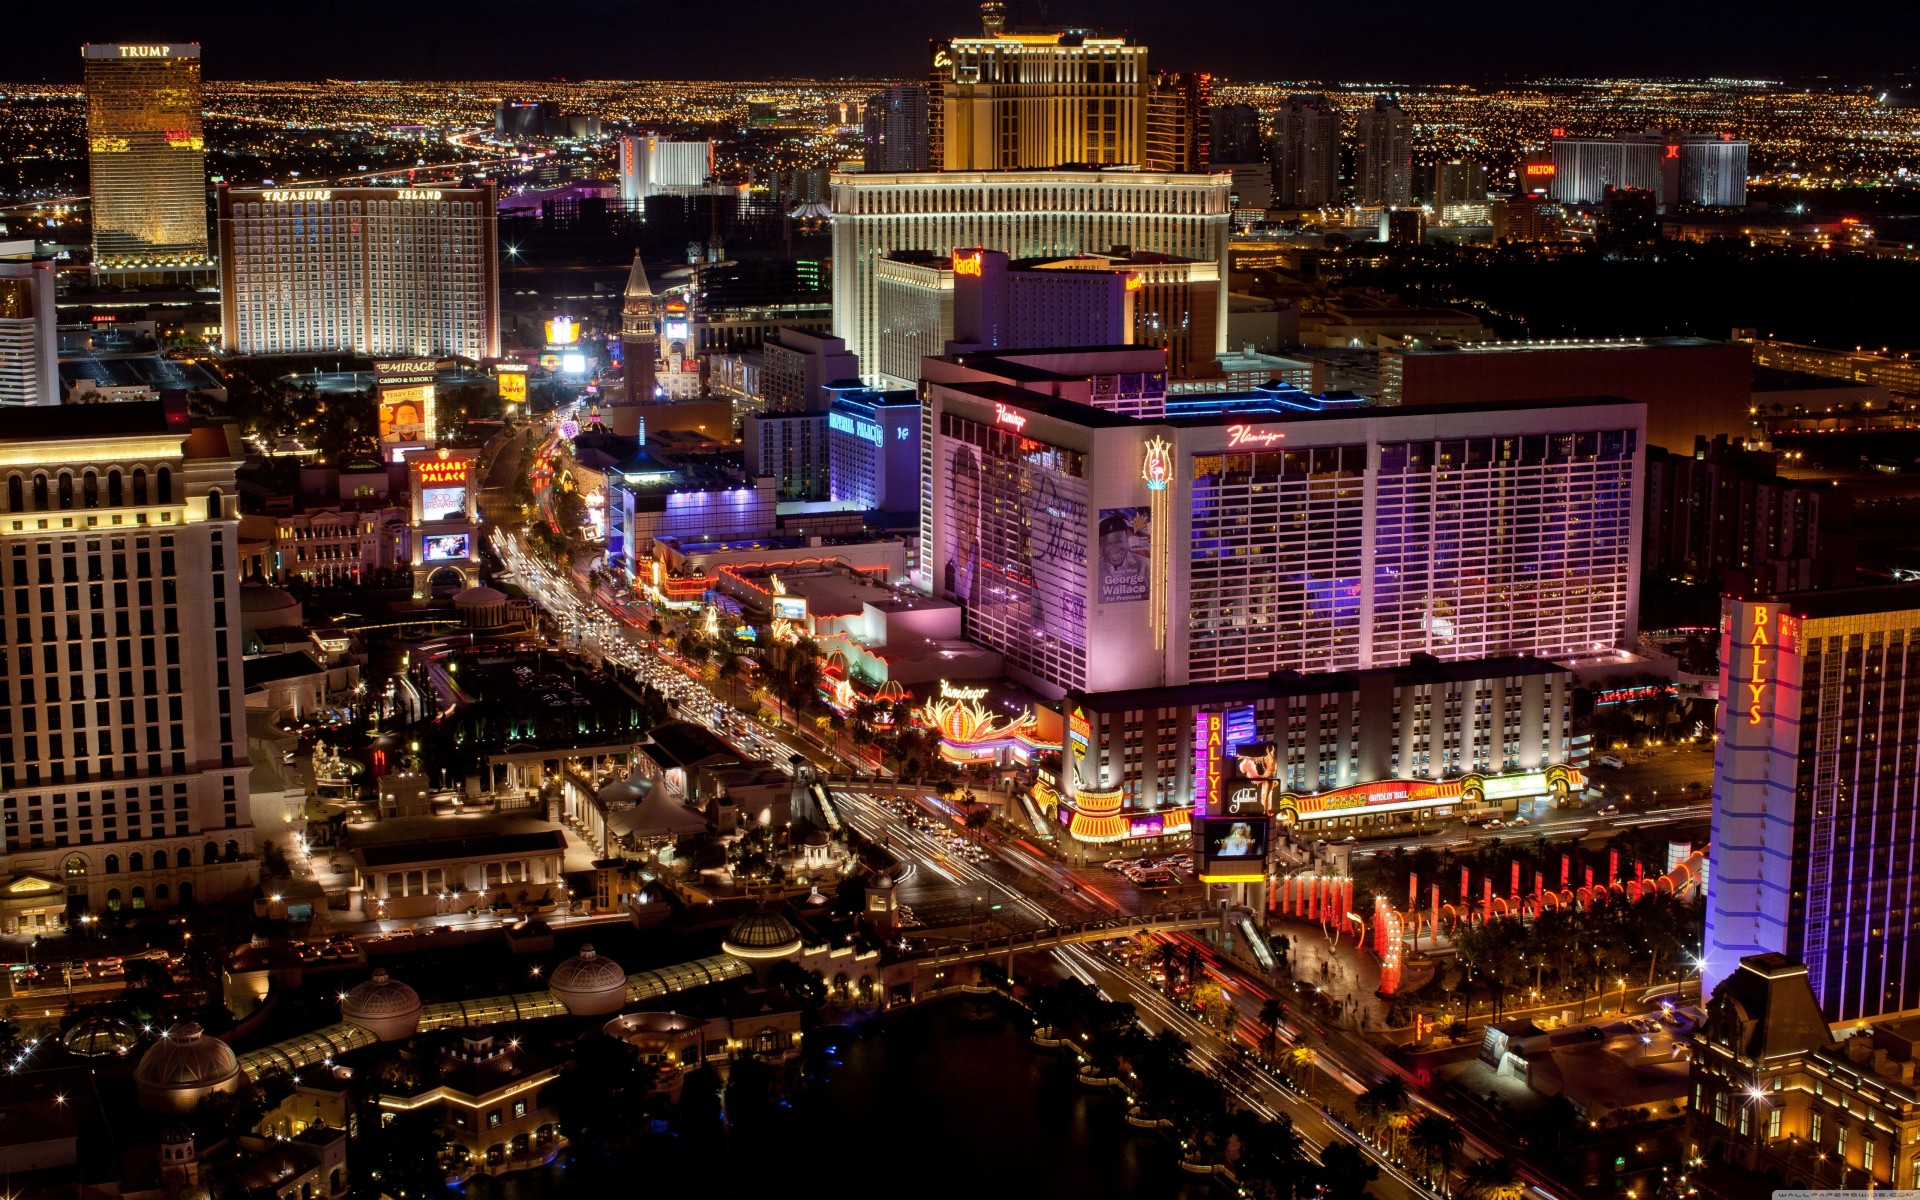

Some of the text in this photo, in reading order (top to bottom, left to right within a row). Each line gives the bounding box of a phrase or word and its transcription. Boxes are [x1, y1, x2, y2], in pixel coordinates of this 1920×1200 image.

[119, 46, 170, 57] TRUMP
[1527, 165, 1555, 175] HILTON
[263, 190, 442, 201] TREASURE ISLAND
[389, 362, 435, 373] MIRAGE
[379, 376, 402, 384] CASINO
[995, 403, 1027, 432] Flamingo
[1226, 424, 1285, 447] Flamingo
[419, 461, 467, 472] CAESARS
[422, 471, 466, 483] PALACE
[1105, 574, 1144, 585] George
[1103, 584, 1146, 596] Wallace
[940, 679, 989, 705] Flamingo
